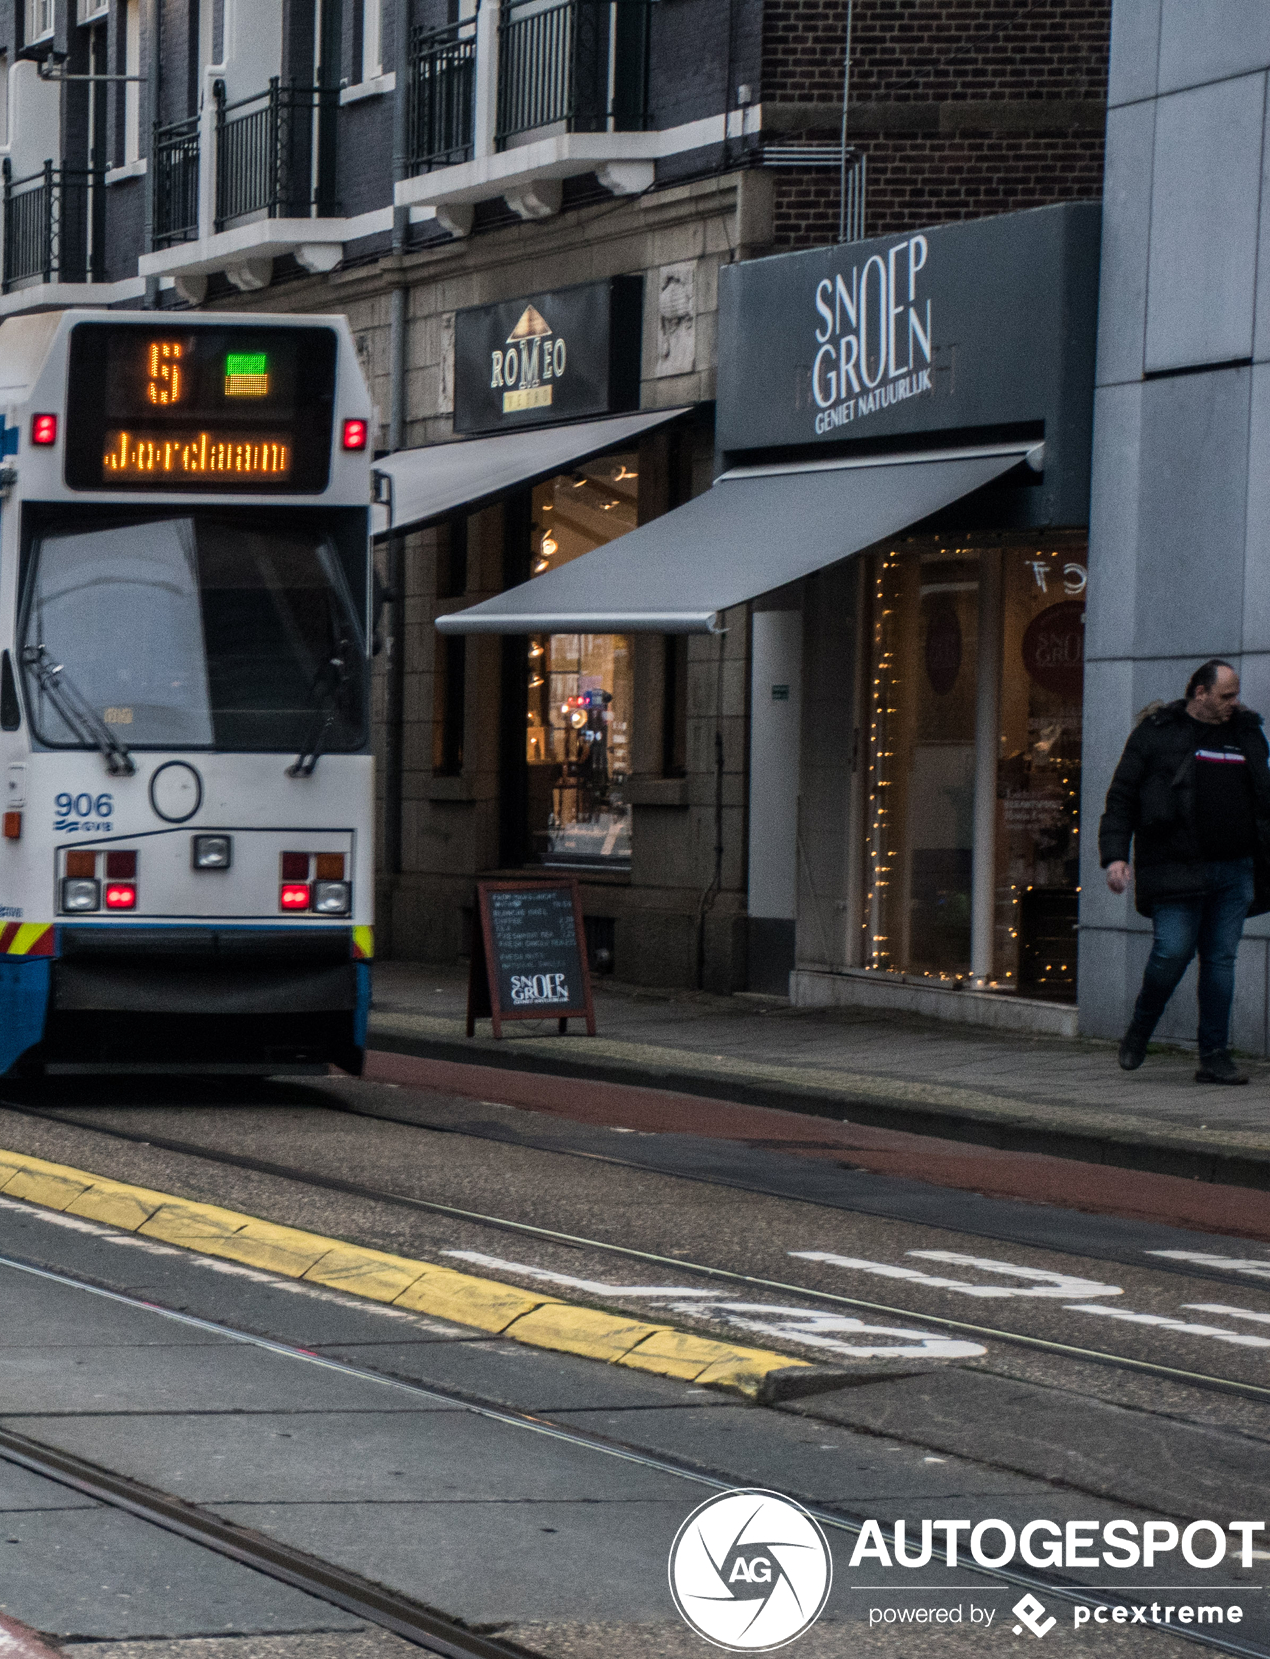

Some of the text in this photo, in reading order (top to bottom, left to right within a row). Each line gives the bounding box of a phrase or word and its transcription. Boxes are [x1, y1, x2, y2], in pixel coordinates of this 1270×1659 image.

[815, 234, 928, 366] SNOEP
[491, 336, 566, 390] ROMEO
[813, 275, 931, 408] GROEN
[151, 343, 181, 403] 5
[815, 368, 932, 435] GENIET NATUURLIJK
[104, 432, 286, 471] Jordaan
[55, 793, 114, 817] 906
[511, 973, 565, 992] SNOEP
[511, 980, 569, 1000] GROEN
